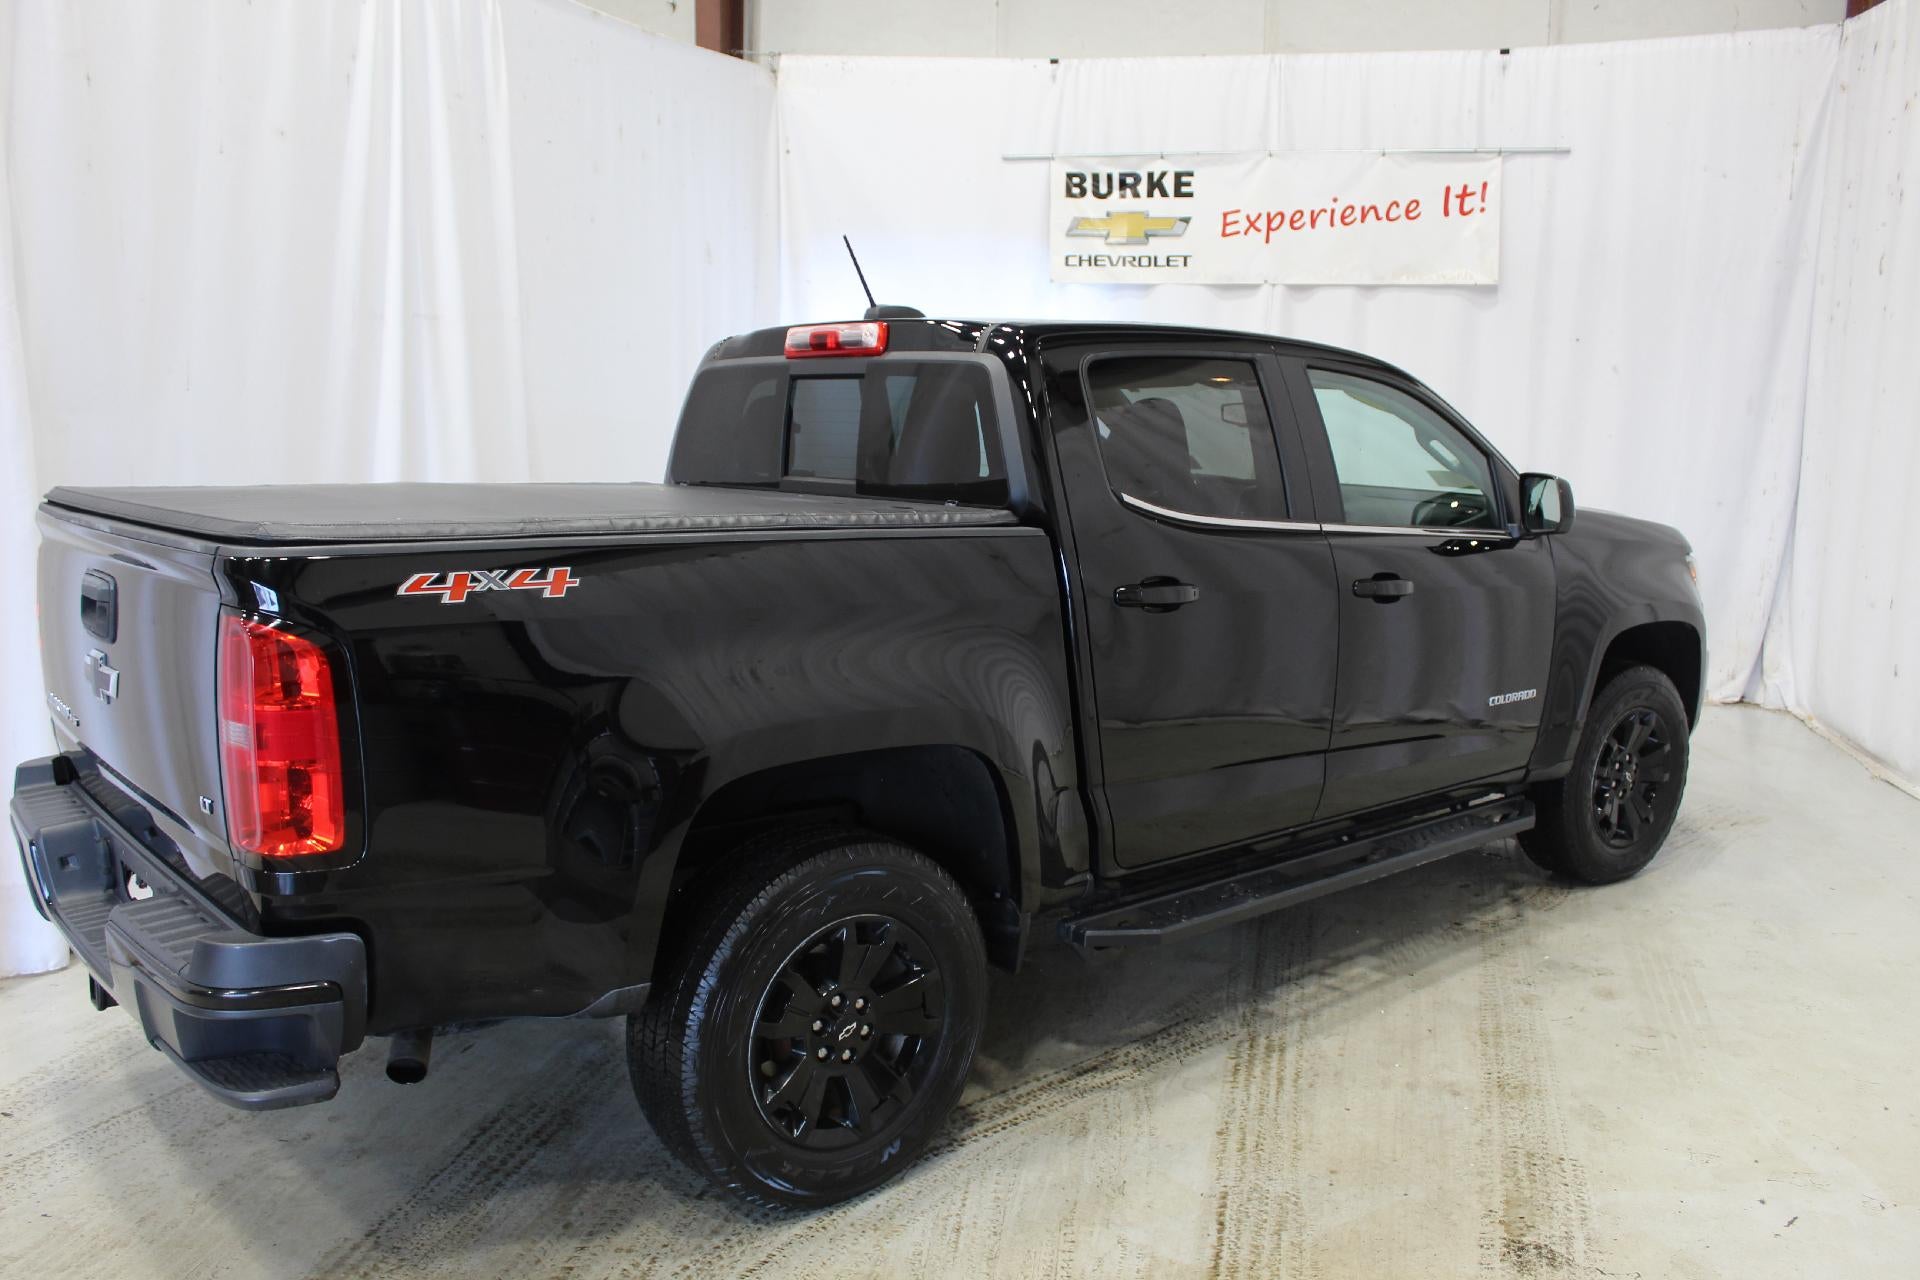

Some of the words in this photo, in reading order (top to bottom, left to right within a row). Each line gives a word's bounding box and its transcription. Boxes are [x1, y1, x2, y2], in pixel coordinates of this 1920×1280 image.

[1065, 170, 1195, 199] BURKE
[1220, 197, 1422, 244] Experience
[1442, 181, 1489, 218] It!
[1064, 254, 1193, 269] CHEVROLET
[1488, 689, 1537, 706] COLORADO
